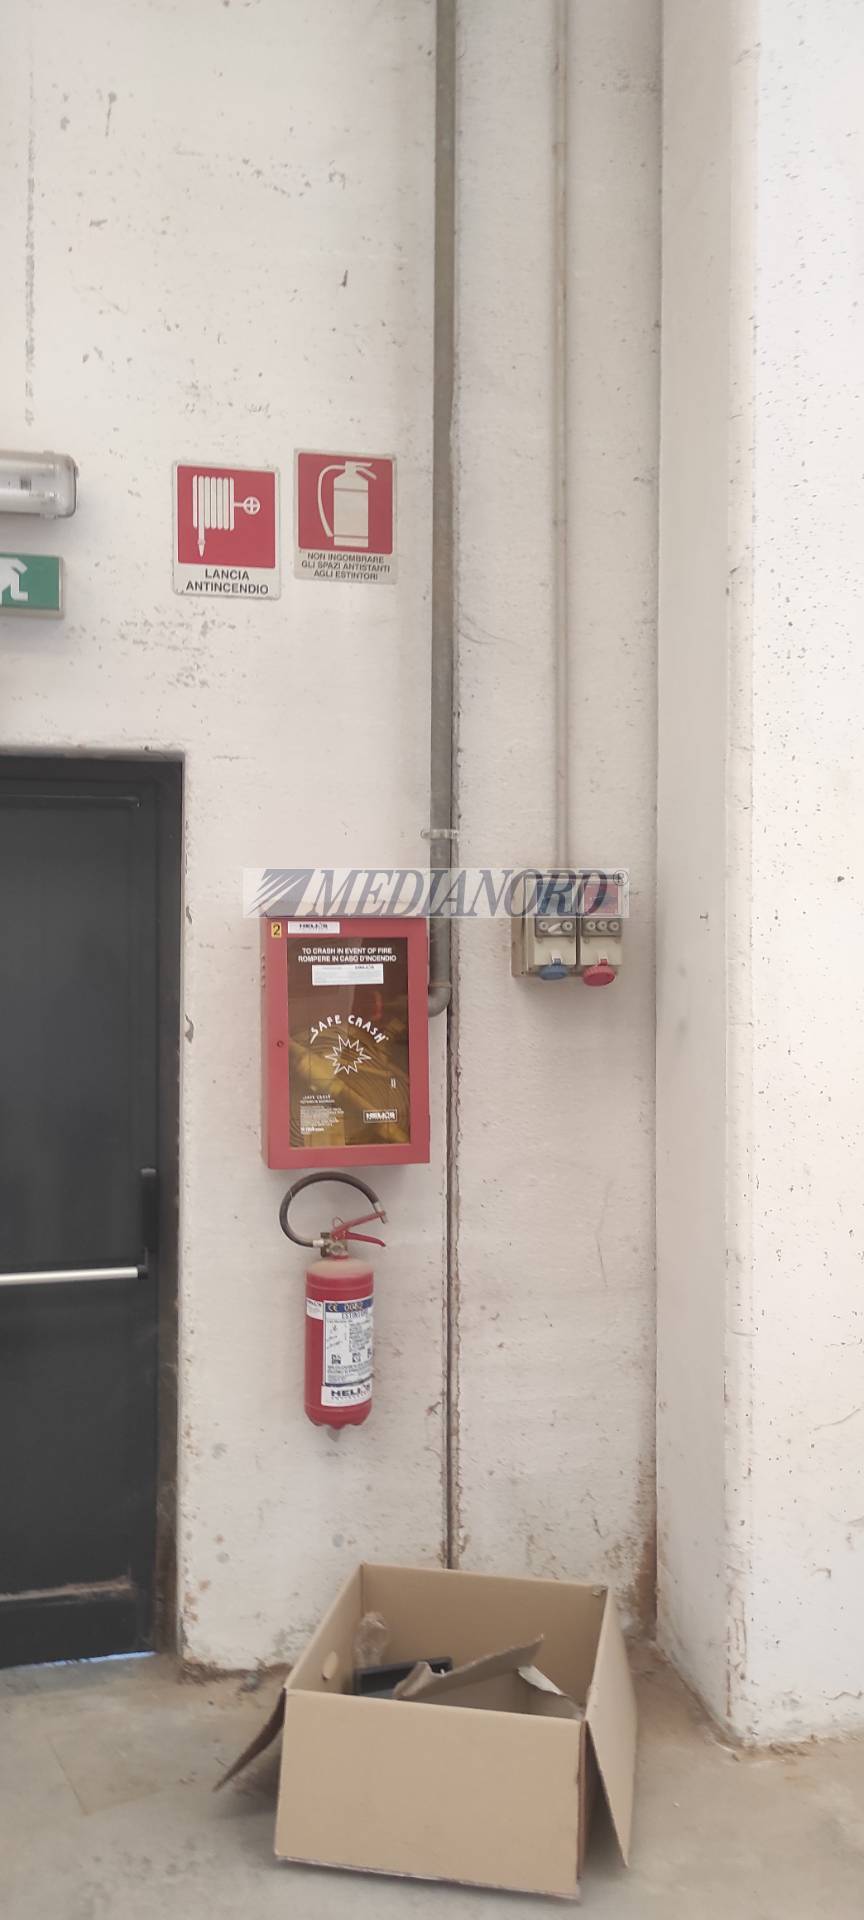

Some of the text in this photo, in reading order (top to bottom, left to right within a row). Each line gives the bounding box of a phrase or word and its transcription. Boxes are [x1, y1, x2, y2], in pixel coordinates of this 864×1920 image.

[307, 552, 384, 564] NON INGOMBRARE
[301, 560, 390, 573] GLI SPAZI ANTISTANTI
[205, 568, 249, 580] LANCIA
[314, 569, 378, 581] AGLI ESTINTORI
[186, 581, 269, 595] ANTINCENDIO
[272, 924, 281, 936] 2
[302, 947, 311, 955] TO
[312, 947, 336, 955] CRASH
[298, 955, 331, 963] ROMPERE
[309, 1014, 386, 1044] SAFE CRASH
